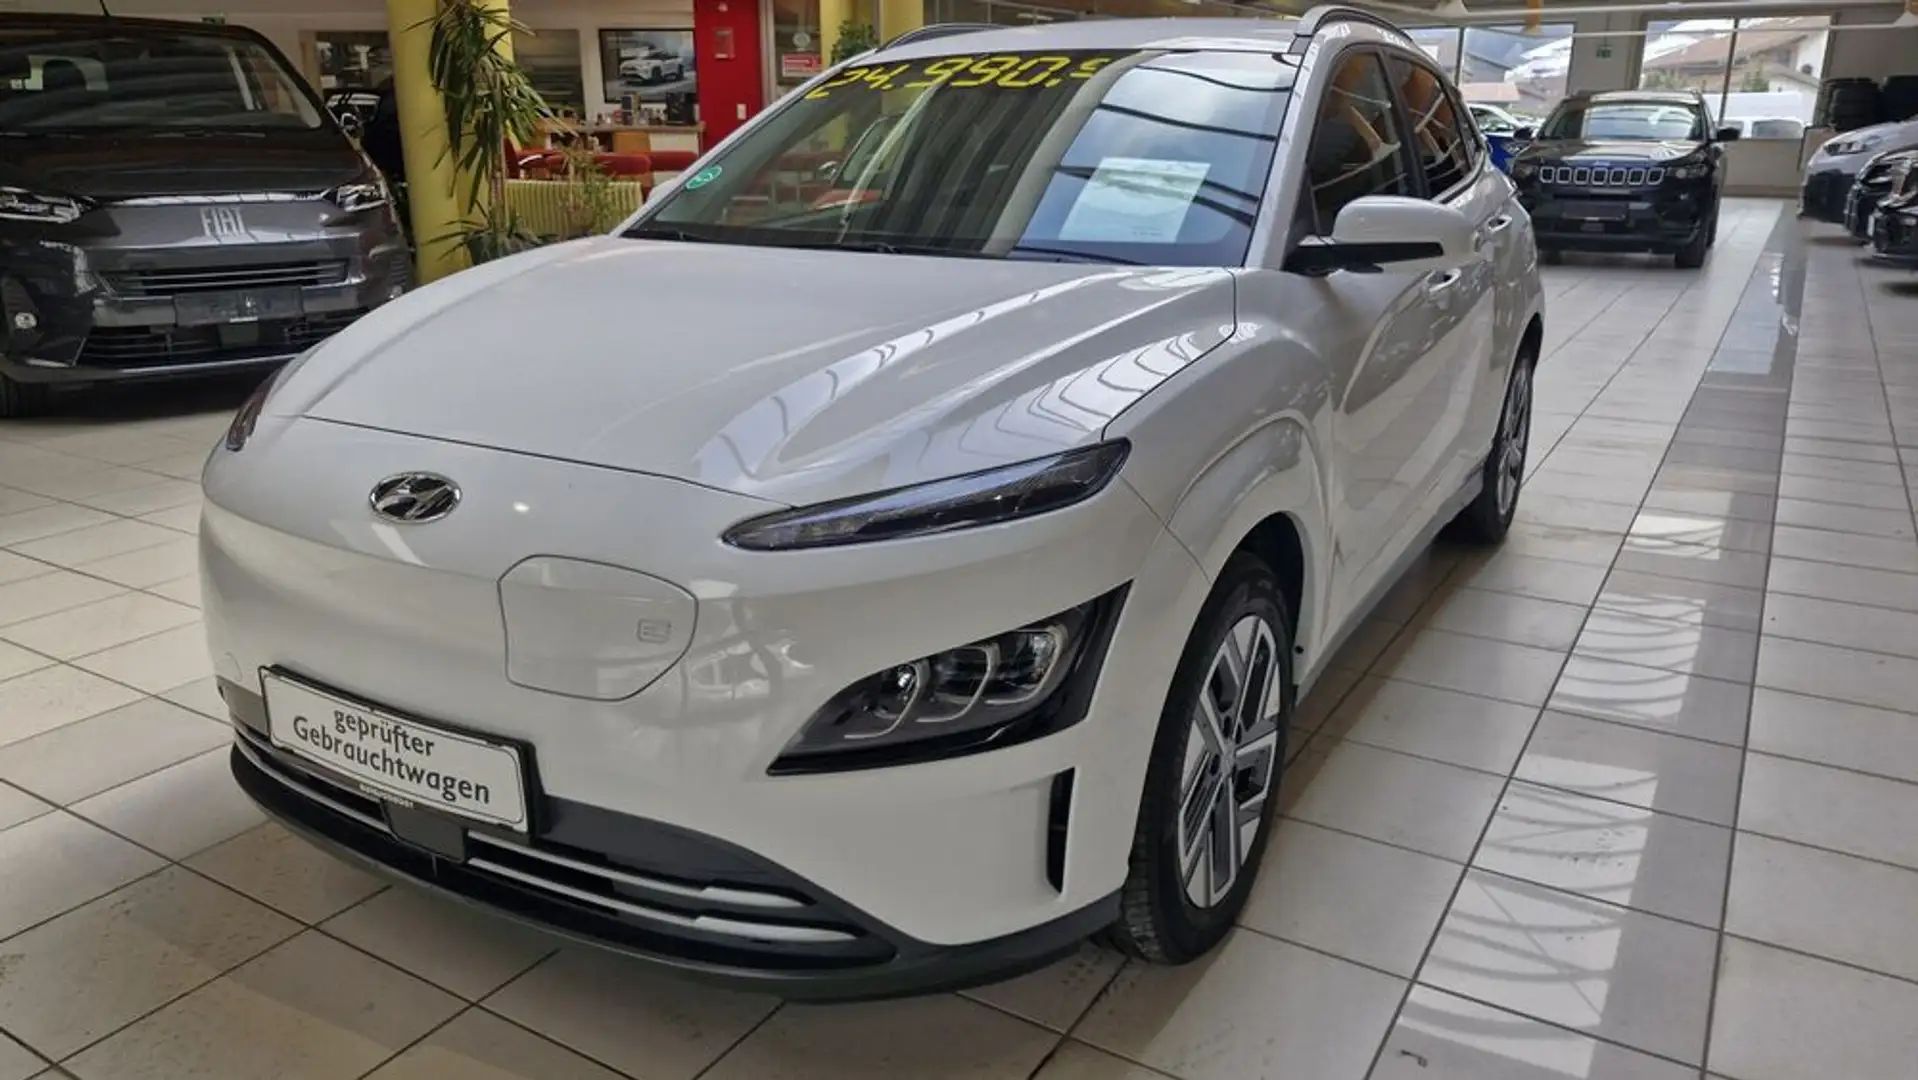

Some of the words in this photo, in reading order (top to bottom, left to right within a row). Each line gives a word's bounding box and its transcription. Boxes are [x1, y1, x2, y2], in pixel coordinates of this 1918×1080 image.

[200, 207, 245, 237] FIAT
[333, 709, 435, 757] geprüfter
[292, 715, 490, 804] Gebrauchtwagen
